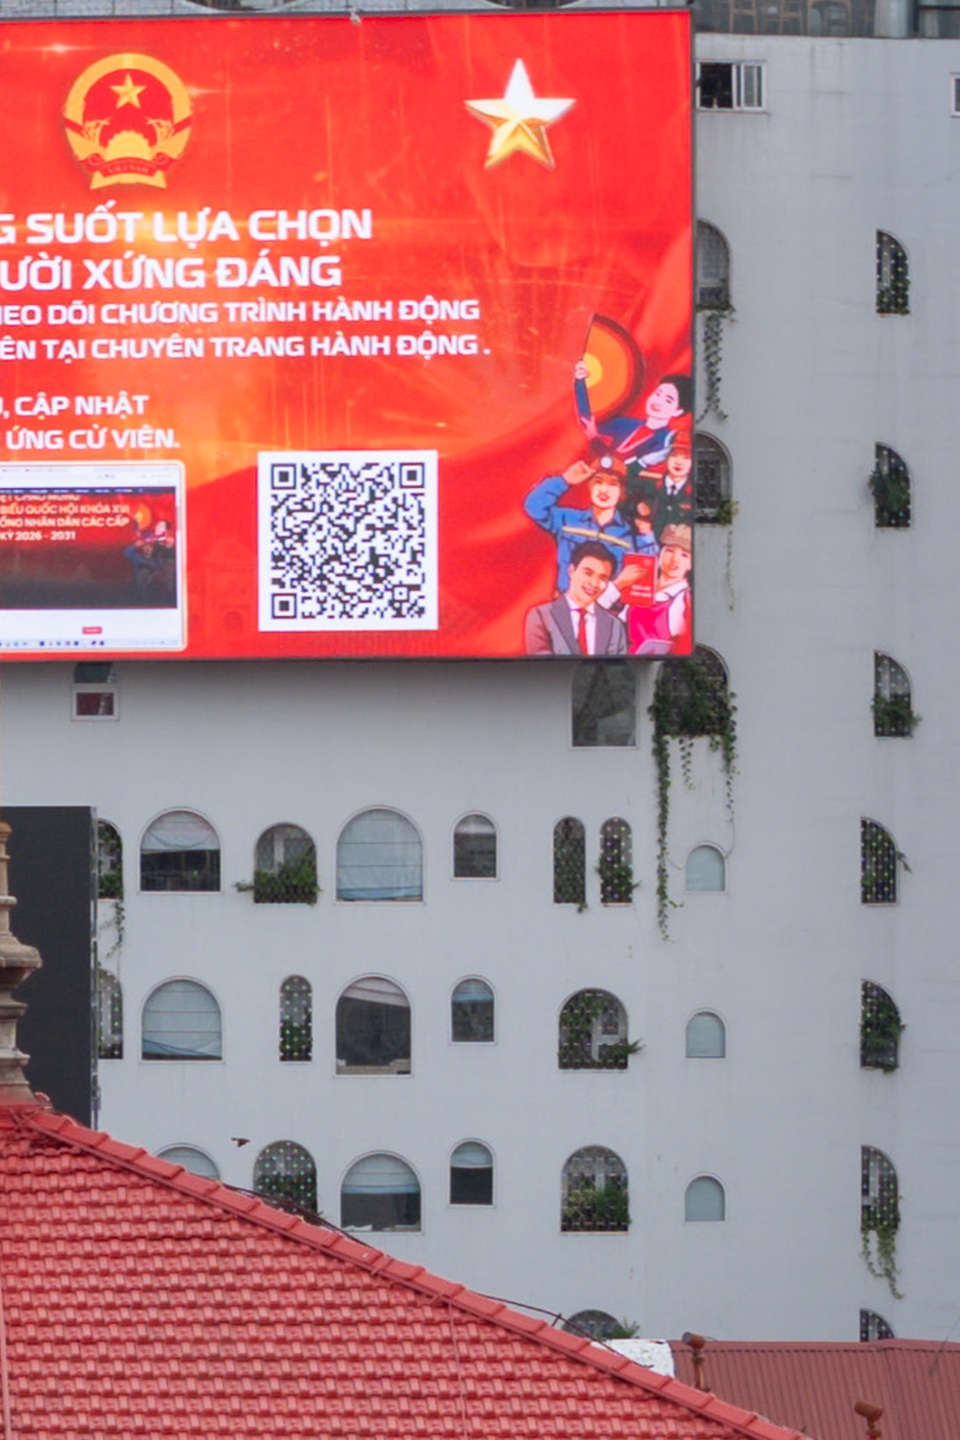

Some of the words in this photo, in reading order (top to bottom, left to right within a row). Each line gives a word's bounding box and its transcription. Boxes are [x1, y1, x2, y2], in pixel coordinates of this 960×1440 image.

[27, 200, 143, 244] SUỐT
[153, 207, 239, 249] LỰA
[249, 208, 372, 247] CHỌN
[83, 250, 206, 289] XỨNG
[216, 249, 342, 287] ĐÁNG
[48, 300, 94, 325] DÕI
[101, 300, 218, 325] CHƯƠNG
[224, 297, 306, 322] TRÌNH
[312, 296, 392, 321] HÀNH
[398, 295, 480, 325] ĐỘNG
[41, 338, 85, 364] TẠI
[91, 333, 204, 360] CHUYÊN
[210, 336, 304, 358] TRANG
[310, 330, 390, 356] HÀNH
[14, 393, 69, 420] CẬP
[75, 391, 149, 419] NHẬT
[6, 426, 64, 450] ỨNG
[69, 424, 107, 450] CỬ
[111, 424, 180, 450] VIÊN.
